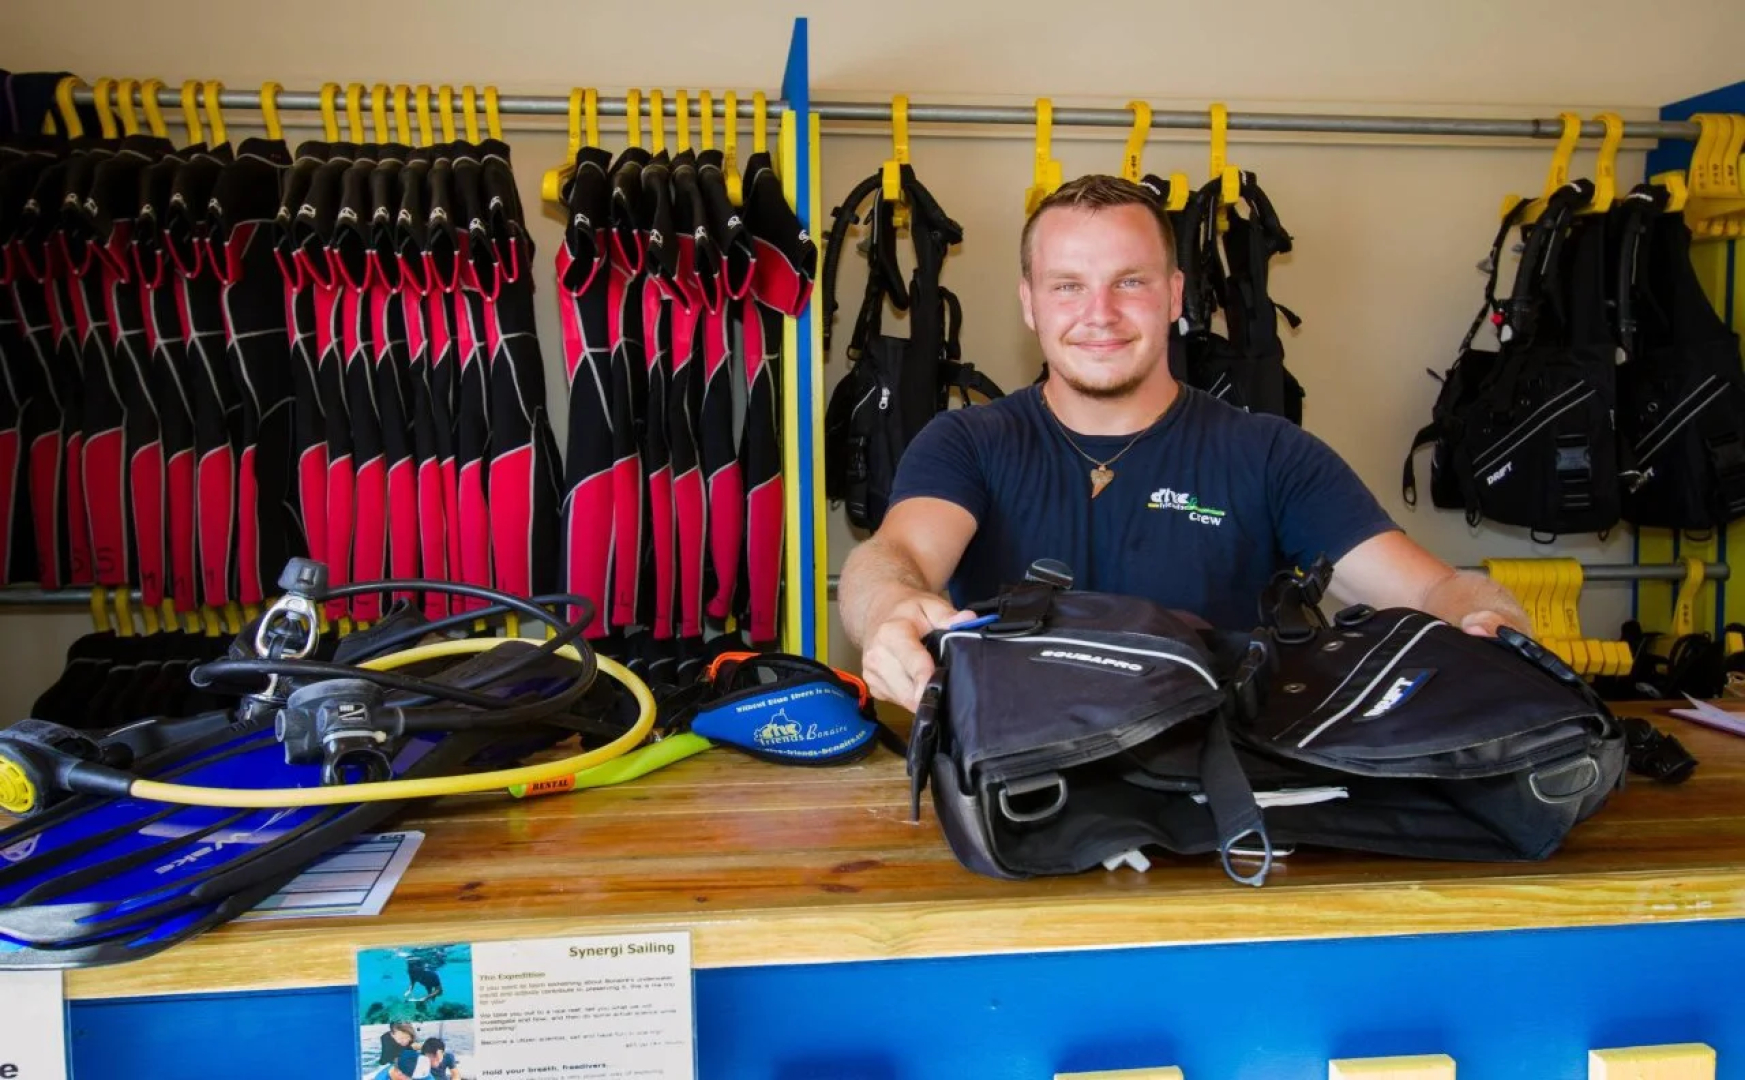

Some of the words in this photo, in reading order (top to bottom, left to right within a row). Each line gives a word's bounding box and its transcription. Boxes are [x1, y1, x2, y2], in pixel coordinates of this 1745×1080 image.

[1040, 650, 1143, 671] SCUBAPRO
[806, 723, 847, 740] Bonaire
[532, 779, 568, 791] RENTAL
[568, 943, 623, 959] Synergi
[626, 941, 675, 955] Sailing
[498, 970, 546, 982] Expedition
[481, 1067, 503, 1077] Hold
[505, 1067, 526, 1078] your
